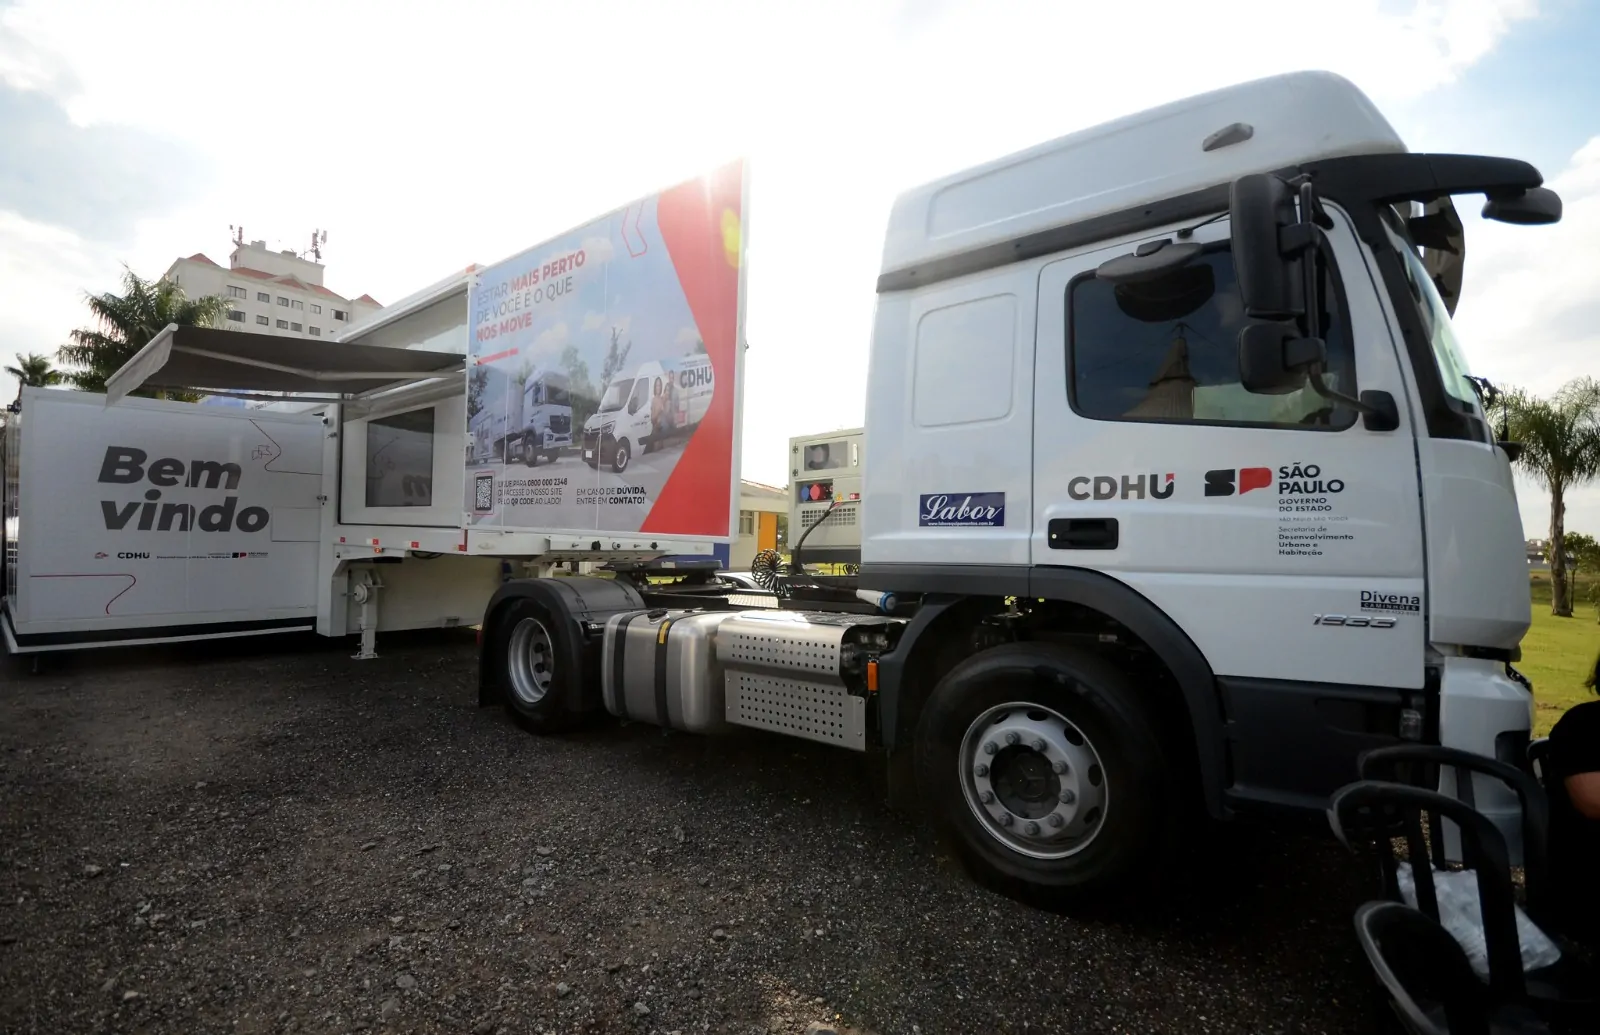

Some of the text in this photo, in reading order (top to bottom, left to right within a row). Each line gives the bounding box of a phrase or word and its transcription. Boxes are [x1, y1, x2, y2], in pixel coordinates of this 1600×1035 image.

[477, 250, 586, 307] ESTAR MAIS PERTO
[476, 276, 573, 325] DE VOCÊ É O QUE
[476, 312, 532, 343] NOS MOVE
[680, 365, 712, 389] CDHU
[98, 445, 242, 490] Bem
[1279, 462, 1321, 479] SÃO
[527, 479, 541, 487] 0800
[553, 477, 568, 486] 2348
[576, 485, 647, 496] EM CASO DE DÚVIDA,
[1067, 473, 1175, 500] CDHU
[1279, 479, 1345, 494] PAULO
[531, 488, 549, 496] NOSSO
[550, 487, 563, 496] SITE
[511, 497, 518, 506] QR
[520, 497, 534, 505] CODE
[576, 496, 645, 505] ENTRE EM CONTATO!
[921, 495, 1002, 520] Labor
[1279, 497, 1327, 505] GOVERNO
[100, 488, 270, 533] vindo
[1360, 590, 1420, 605] Divena
